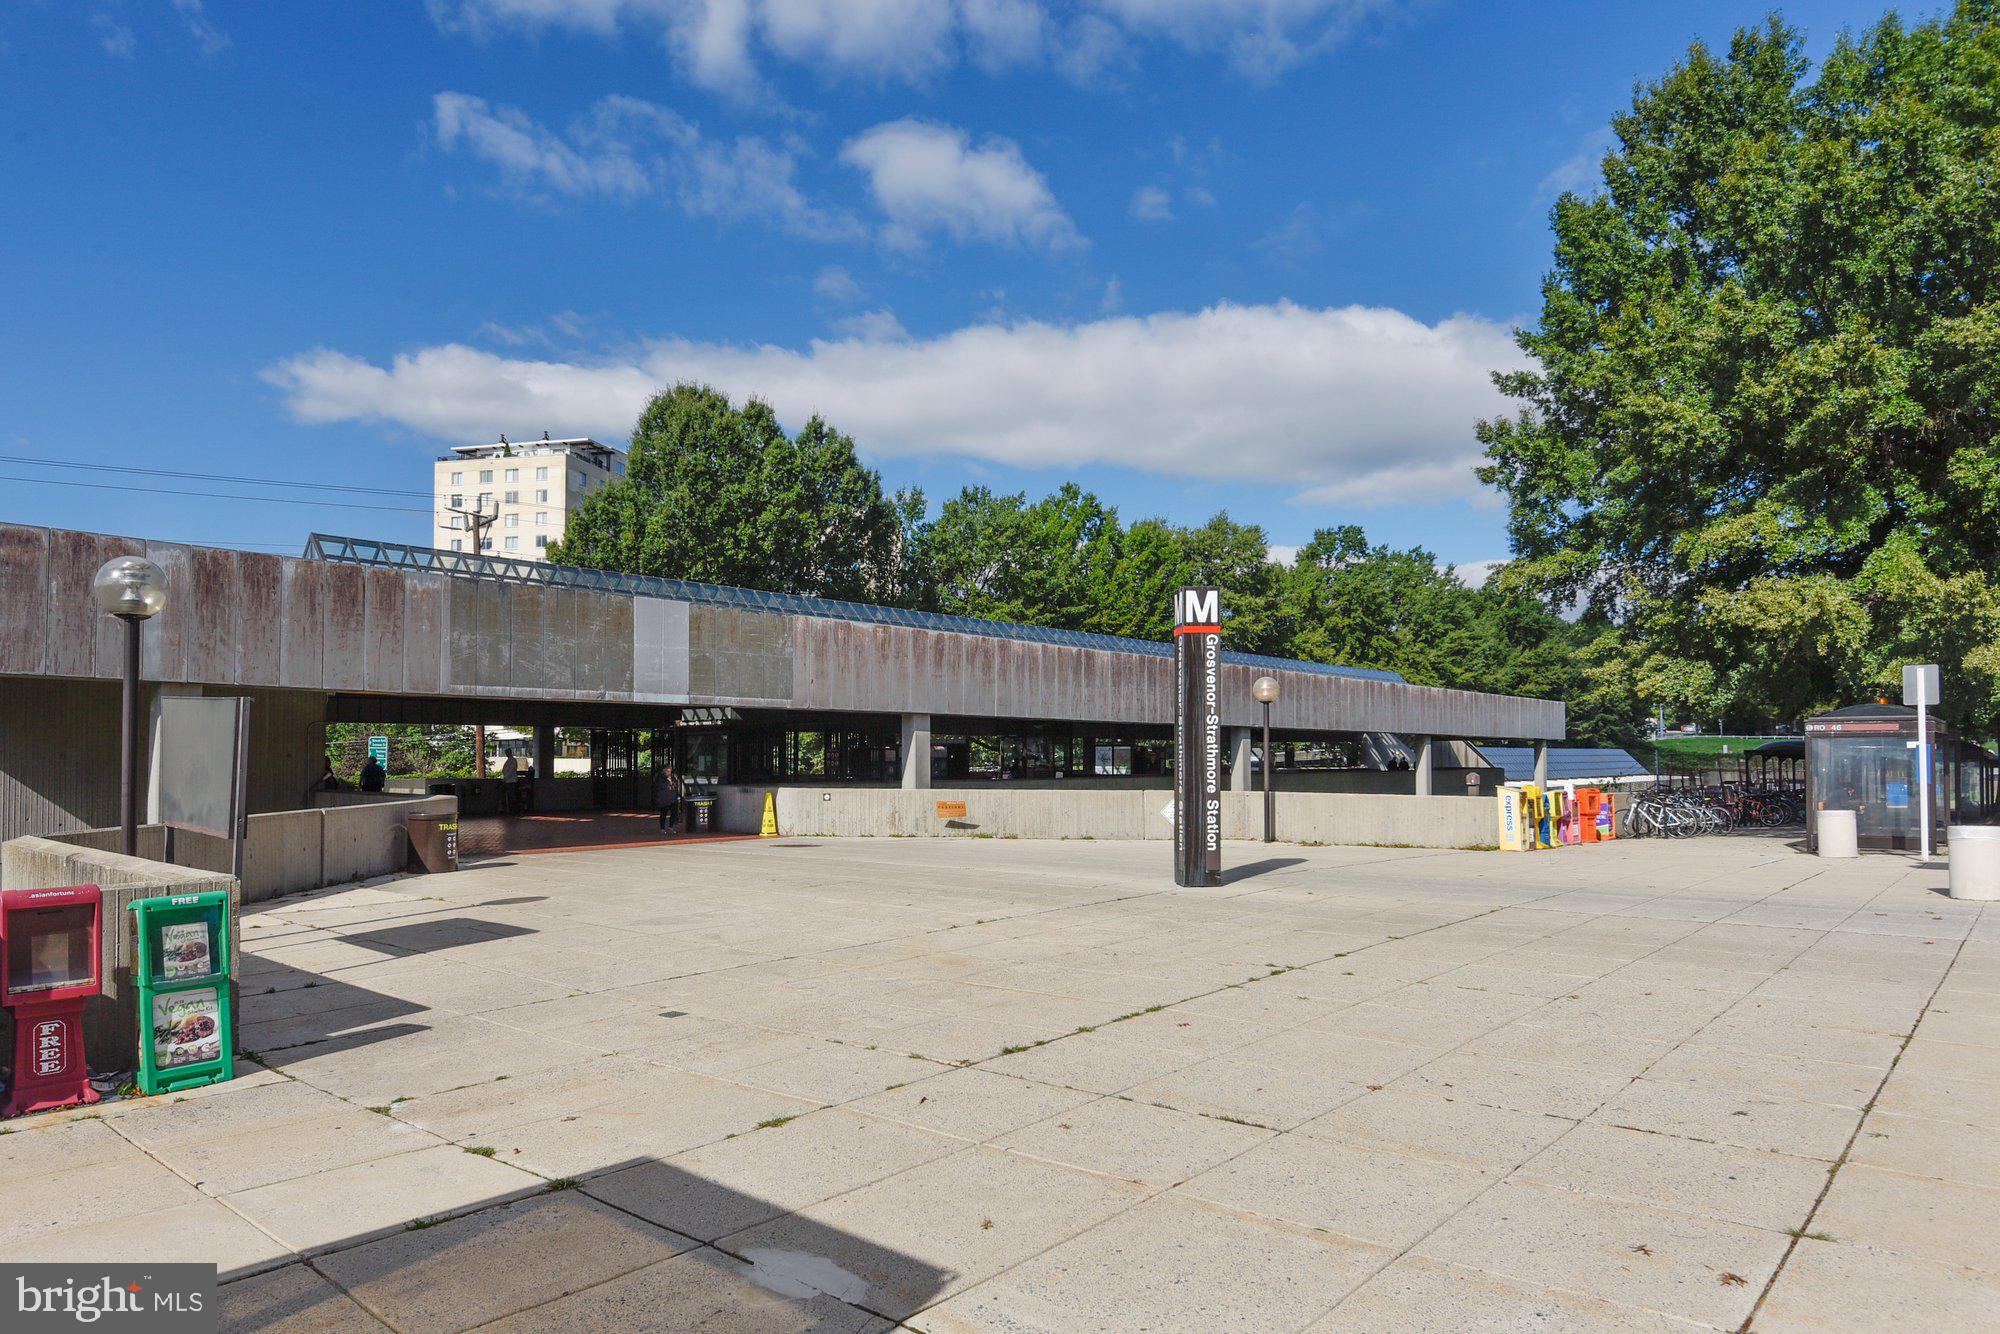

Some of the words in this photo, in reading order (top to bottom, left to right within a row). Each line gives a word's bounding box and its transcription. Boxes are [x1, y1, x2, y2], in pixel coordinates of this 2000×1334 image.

[1185, 590, 1218, 623] M
[1206, 634, 1219, 793] Grosvenor-Strathmore
[1206, 800, 1219, 851] Station
[1505, 795, 1515, 831] express
[171, 895, 199, 906] FREE
[166, 928, 200, 943] Vegan
[158, 997, 205, 1017] Vegan
[39, 1023, 61, 1074] FREE
